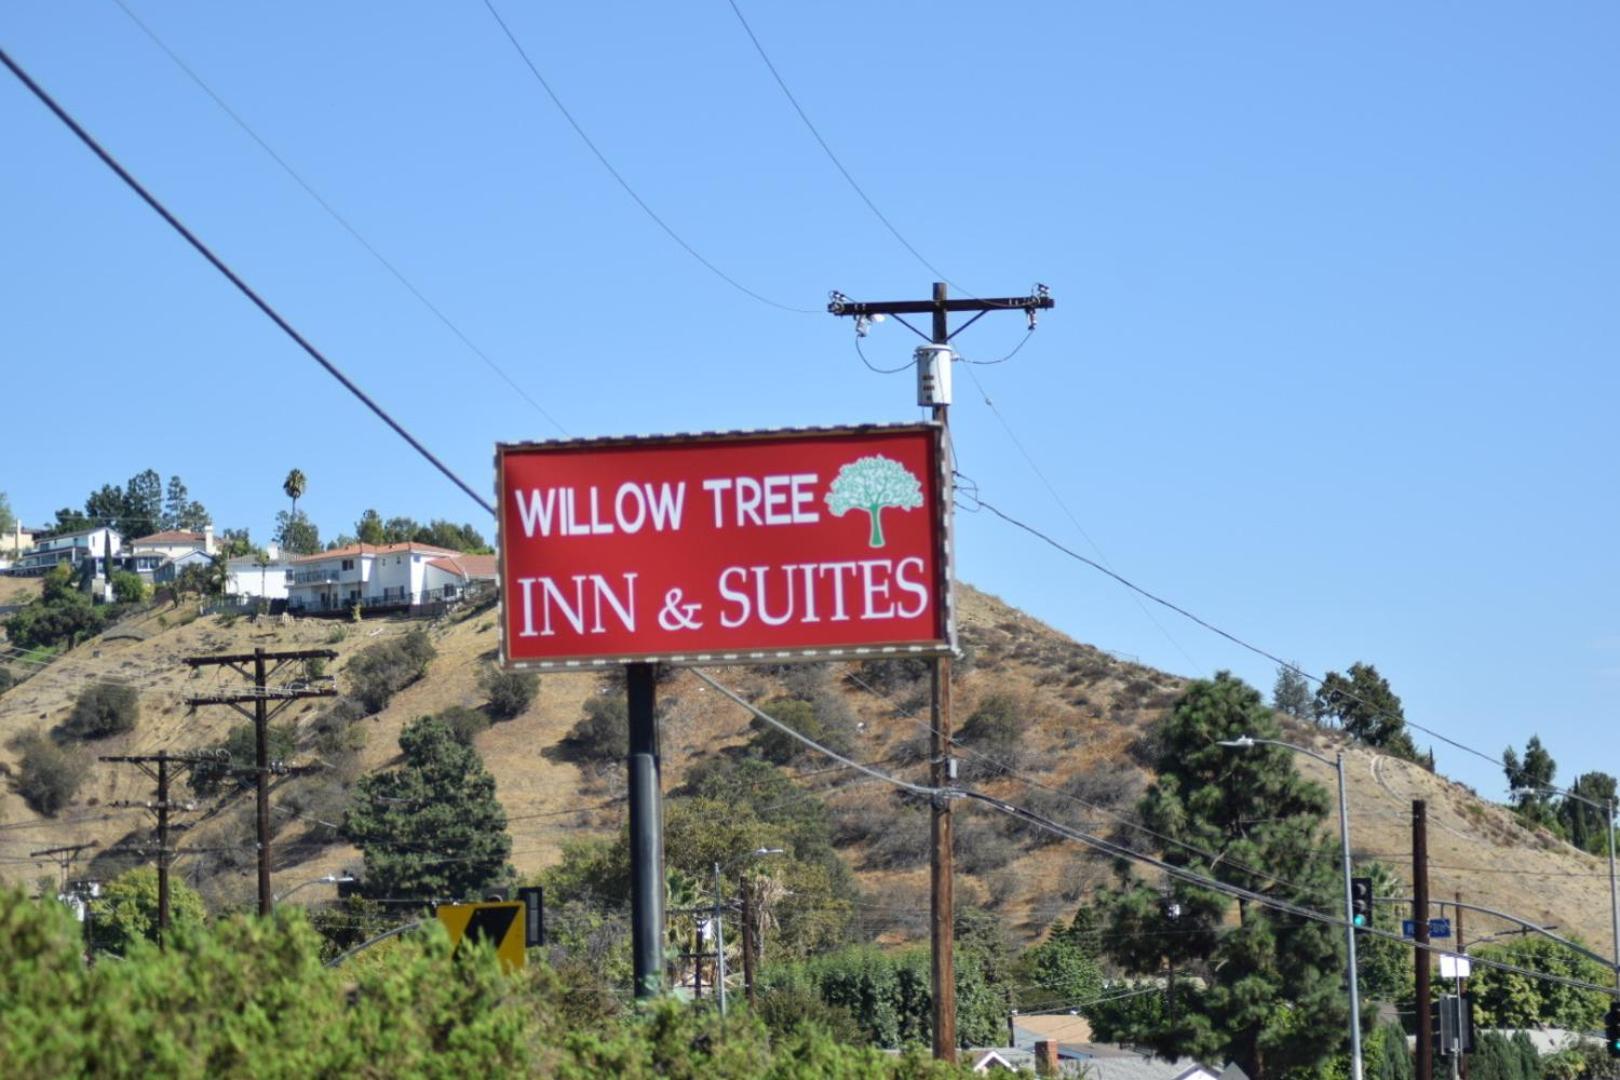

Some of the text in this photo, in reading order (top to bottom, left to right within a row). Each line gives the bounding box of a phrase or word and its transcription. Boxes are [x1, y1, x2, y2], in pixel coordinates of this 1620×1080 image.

[515, 473, 820, 538] WILLOW TREE
[517, 556, 929, 637] INN & SUITES
